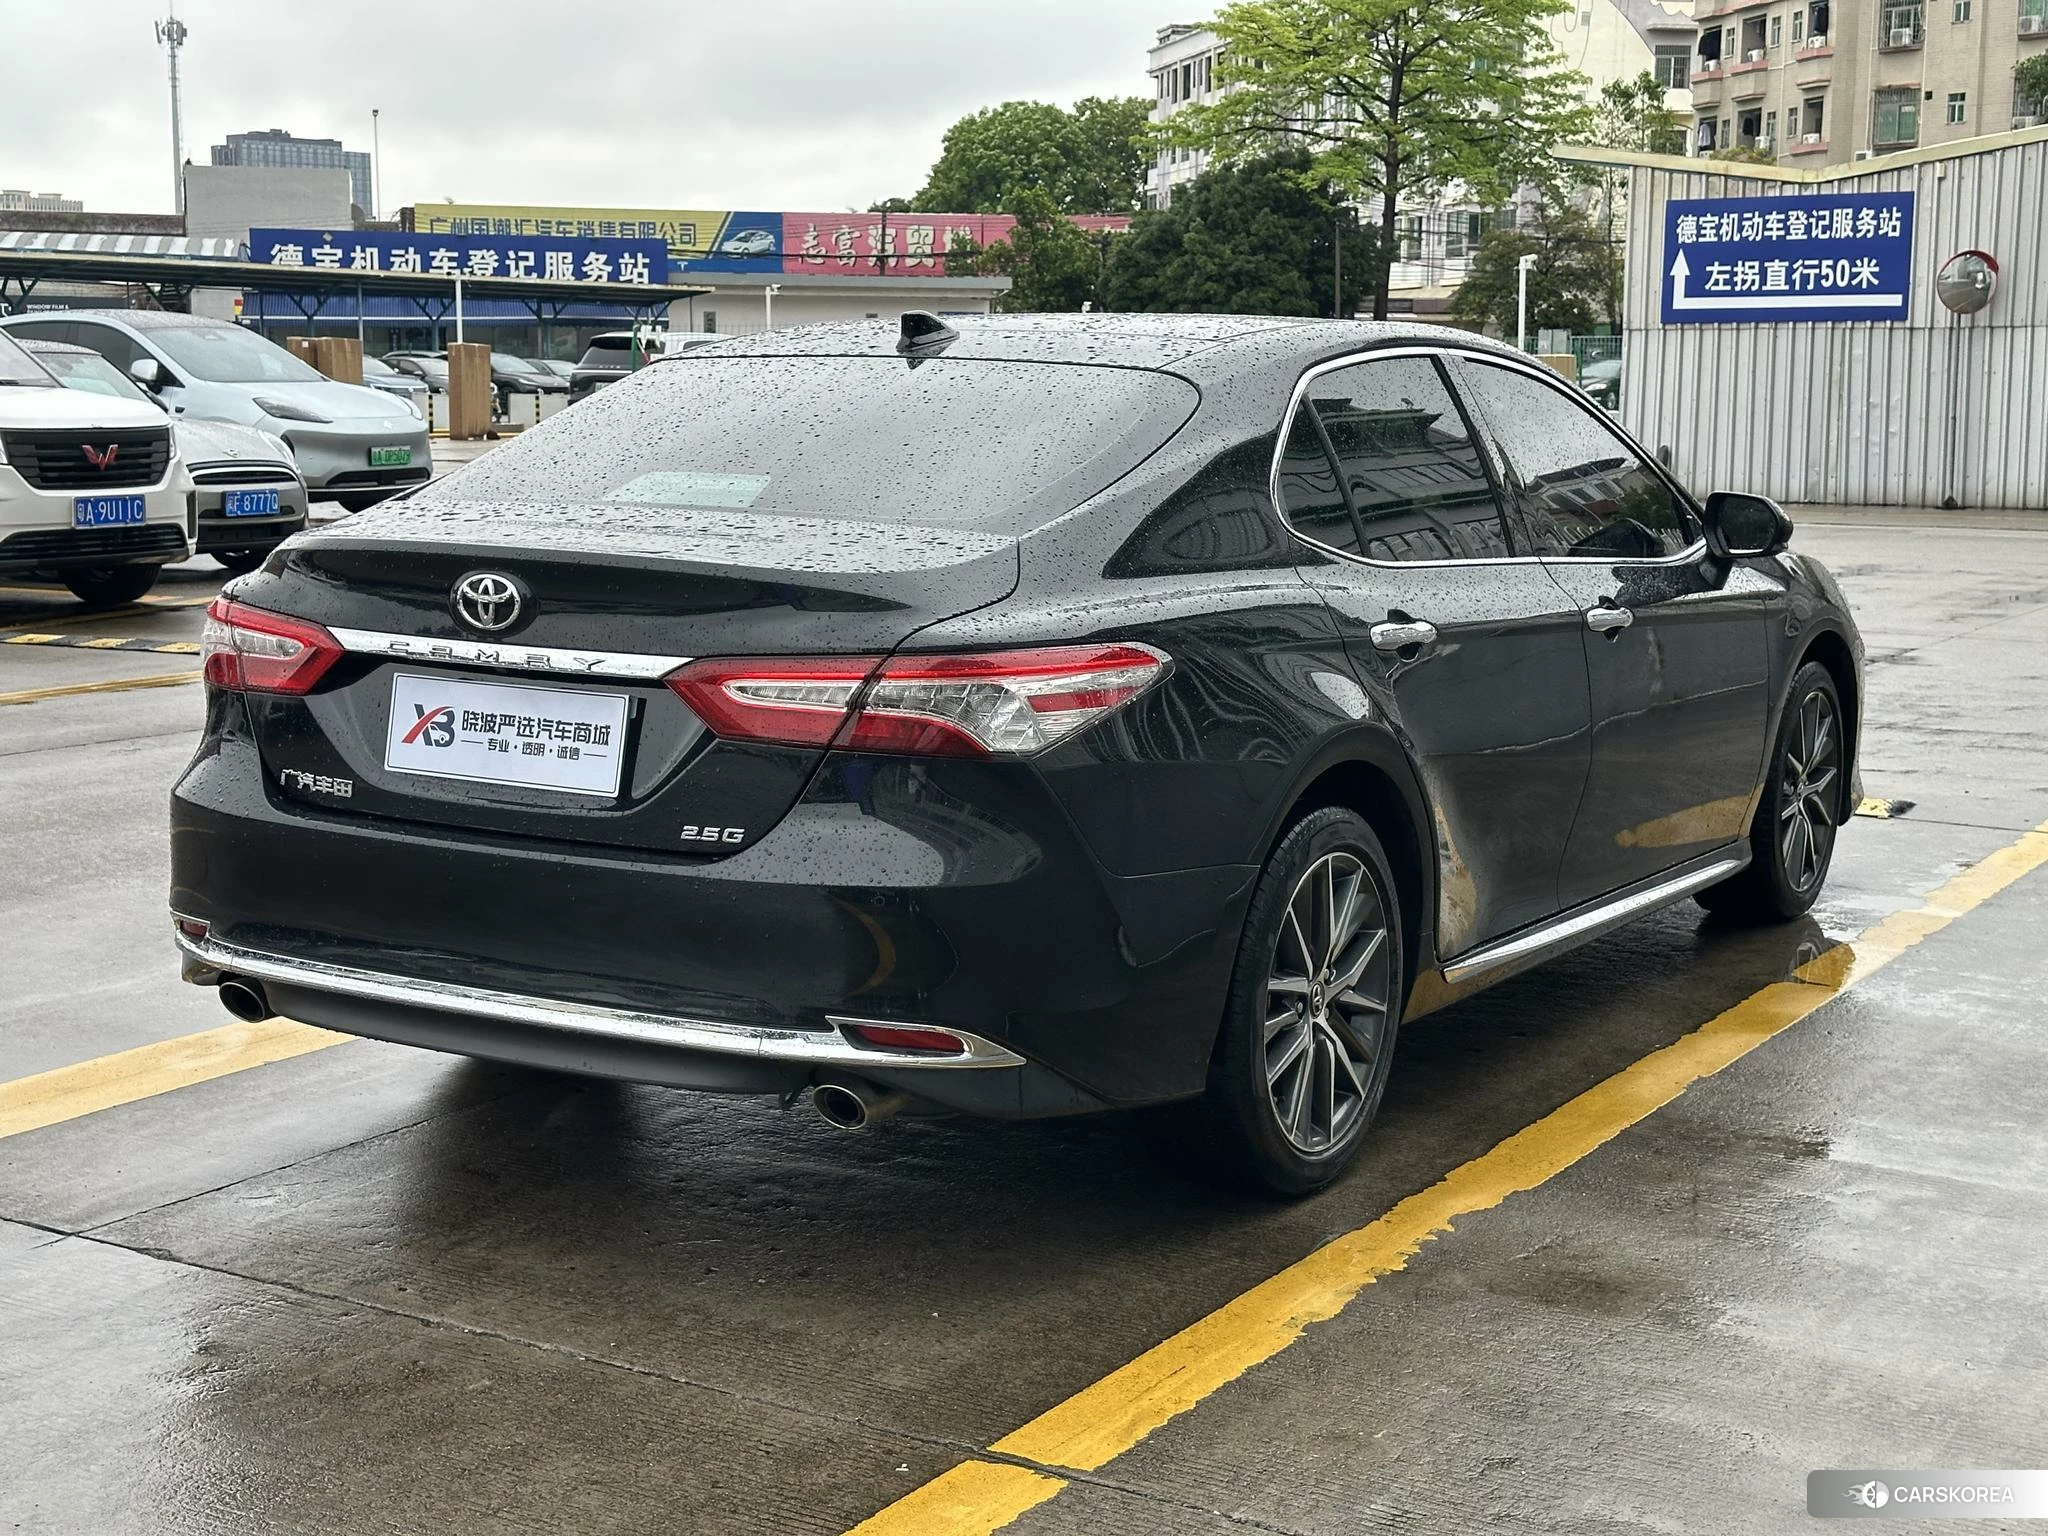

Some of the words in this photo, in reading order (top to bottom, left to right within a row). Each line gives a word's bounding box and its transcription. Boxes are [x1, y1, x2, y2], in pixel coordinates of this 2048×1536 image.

[1676, 207, 1901, 244] 德宝机动车登记服务站
[270, 243, 651, 285] 德宝机动车登记服务站
[1705, 257, 1880, 292] 左拐直行50米
[389, 640, 606, 673] CAMRY
[461, 710, 611, 747] 晓波严选汽车商城
[280, 769, 353, 798] 广汽丰田
